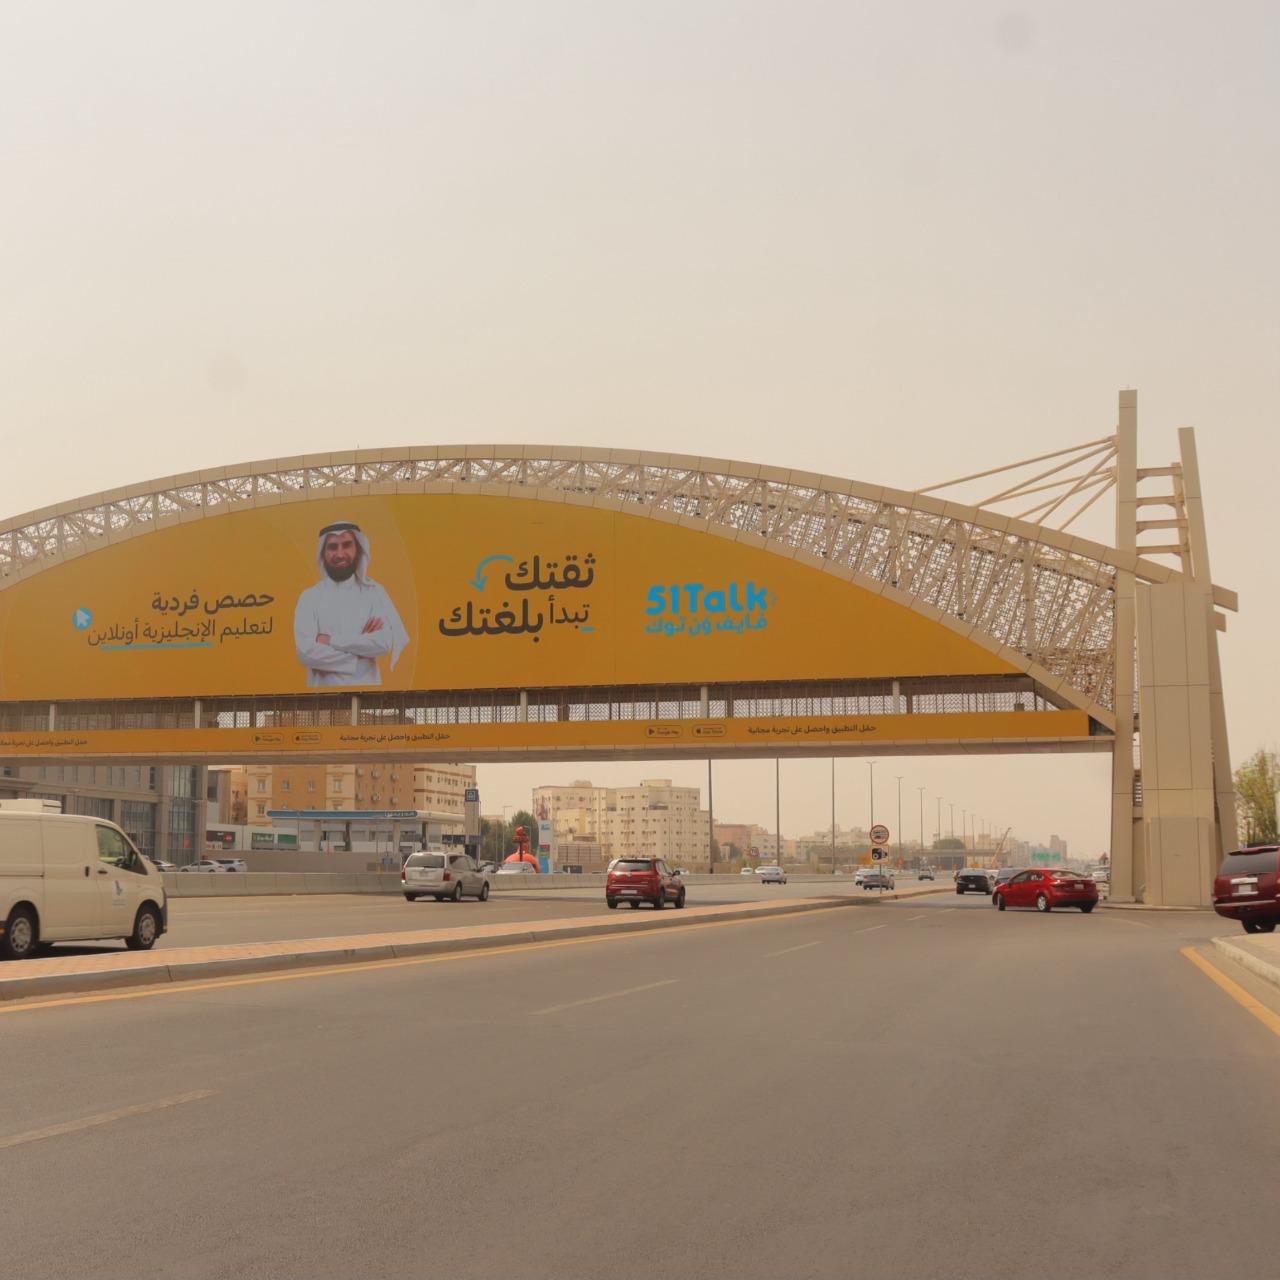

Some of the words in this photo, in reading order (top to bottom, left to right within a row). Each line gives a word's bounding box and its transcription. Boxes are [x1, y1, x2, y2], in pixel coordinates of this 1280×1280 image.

[504, 553, 596, 592] ثقتك
[151, 589, 200, 616] فردية
[204, 592, 275, 614] حصص
[548, 594, 590, 630] تبدأ
[645, 580, 768, 615] 51Talk
[87, 617, 140, 646] أونلاين
[143, 619, 216, 644] الإنجليزية
[219, 616, 273, 643] لتعليم
[438, 598, 544, 643] بلغتك
